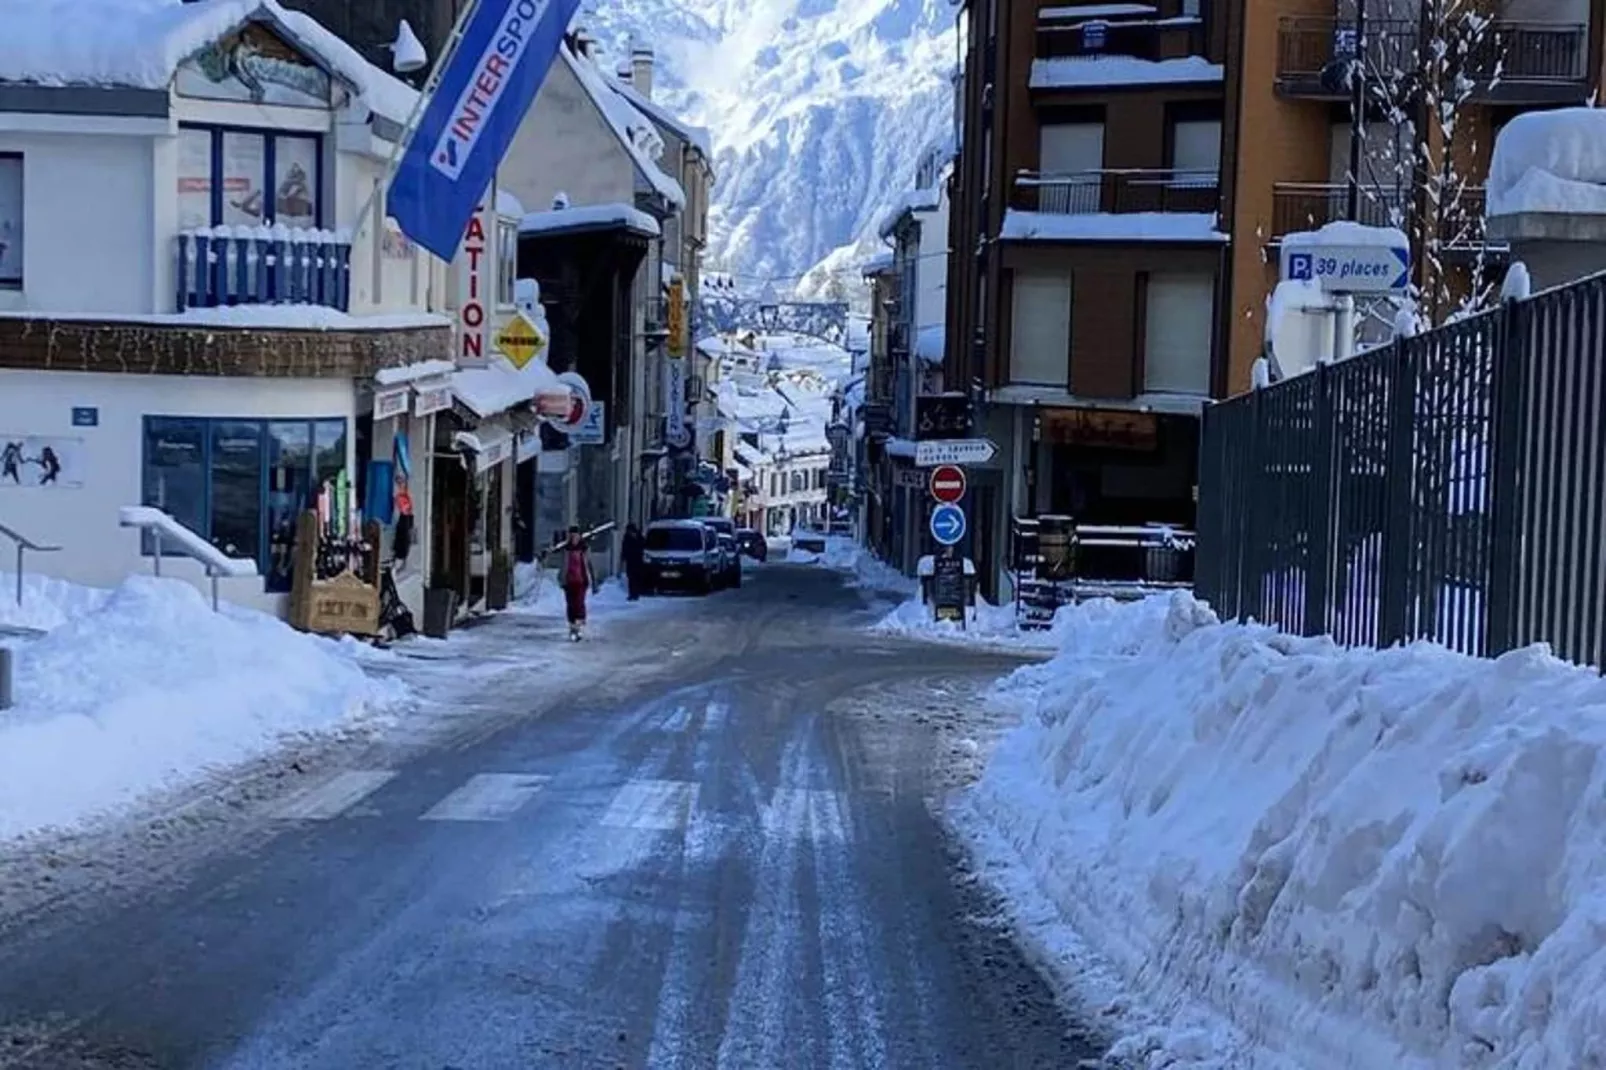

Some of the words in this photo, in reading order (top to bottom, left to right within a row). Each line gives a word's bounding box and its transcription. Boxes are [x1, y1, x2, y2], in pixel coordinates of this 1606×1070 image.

[451, 0, 542, 142] INTERSPO
[462, 206, 485, 358] ATION
[1316, 258, 1337, 275] 39
[1340, 259, 1389, 279] places
